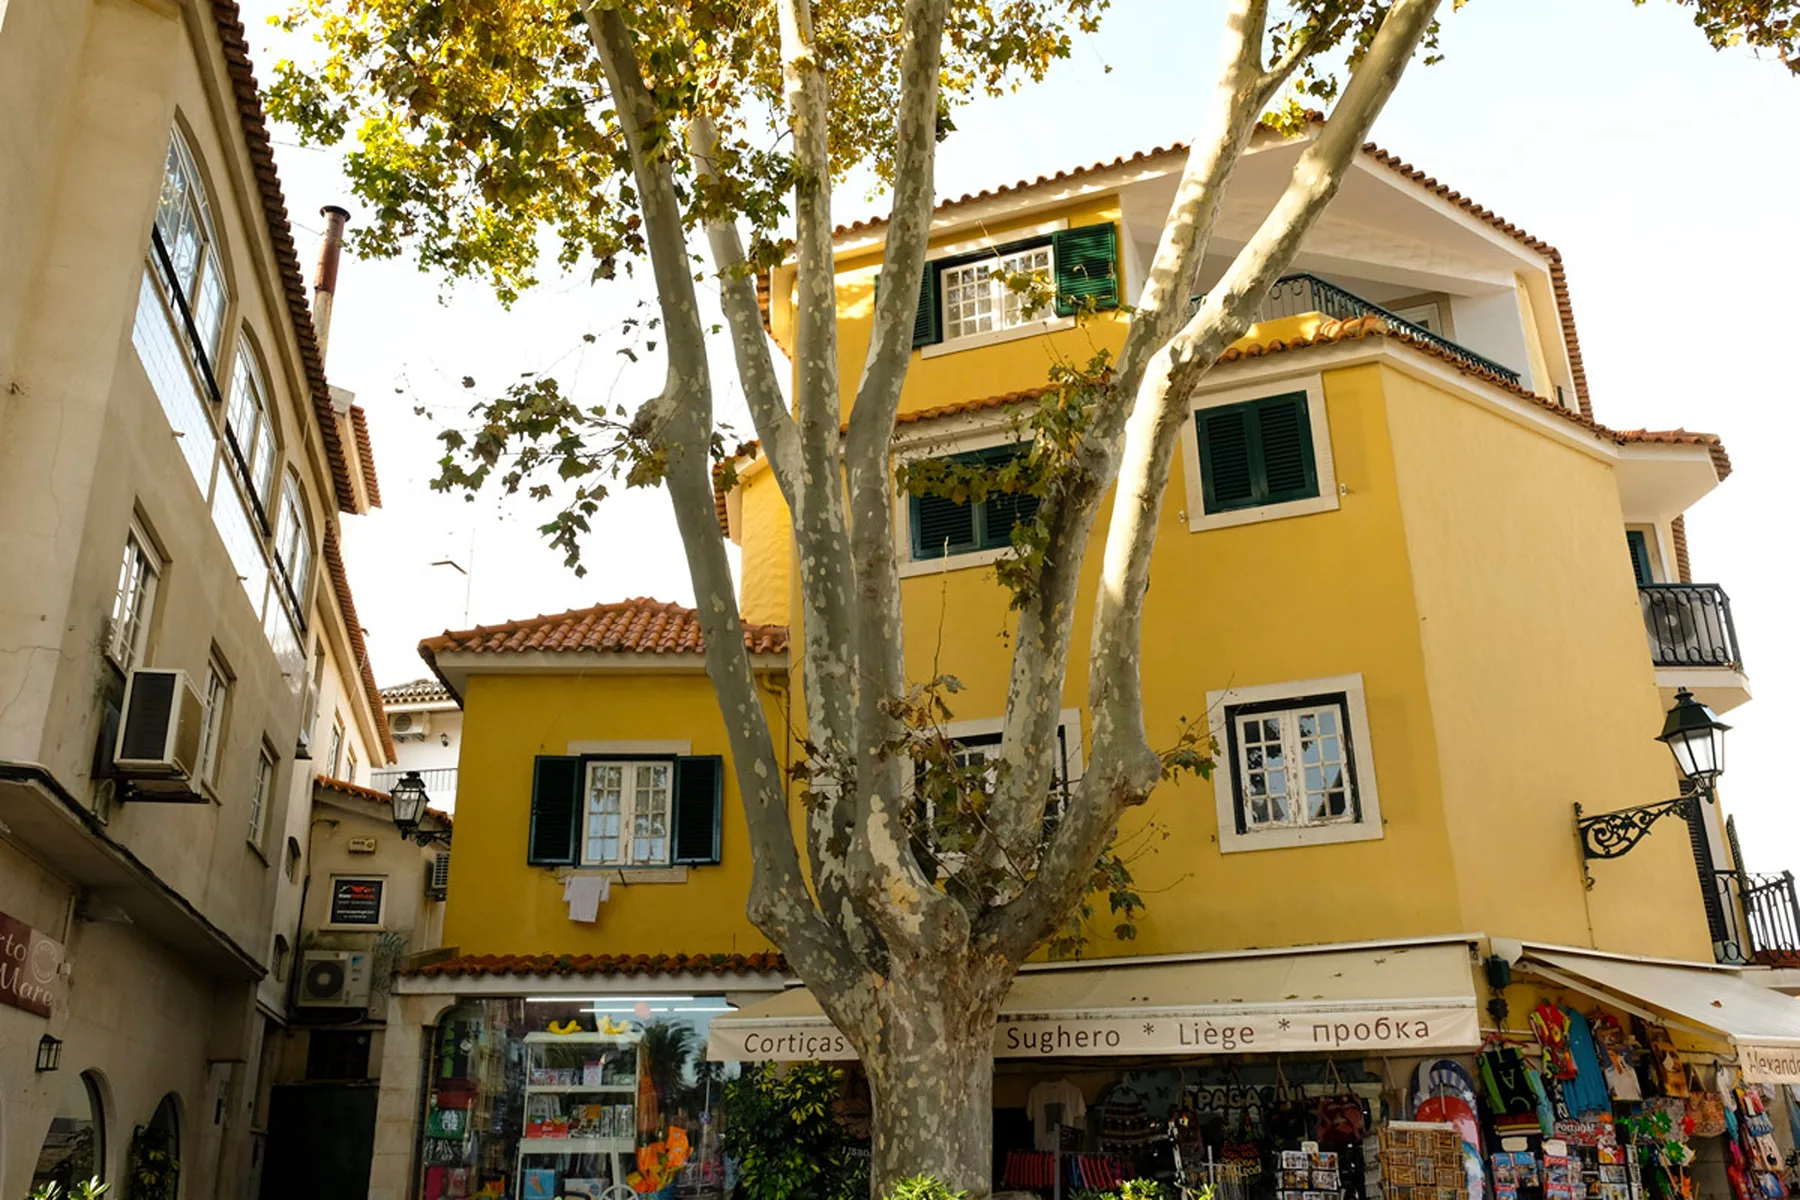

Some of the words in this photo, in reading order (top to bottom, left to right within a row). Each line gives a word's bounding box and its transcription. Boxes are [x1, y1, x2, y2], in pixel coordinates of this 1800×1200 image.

[744, 1032, 844, 1058] Cortiças
[1007, 1024, 1120, 1054] Sughero
[1179, 1020, 1254, 1050] Liège
[1313, 1017, 1429, 1047] пробка
